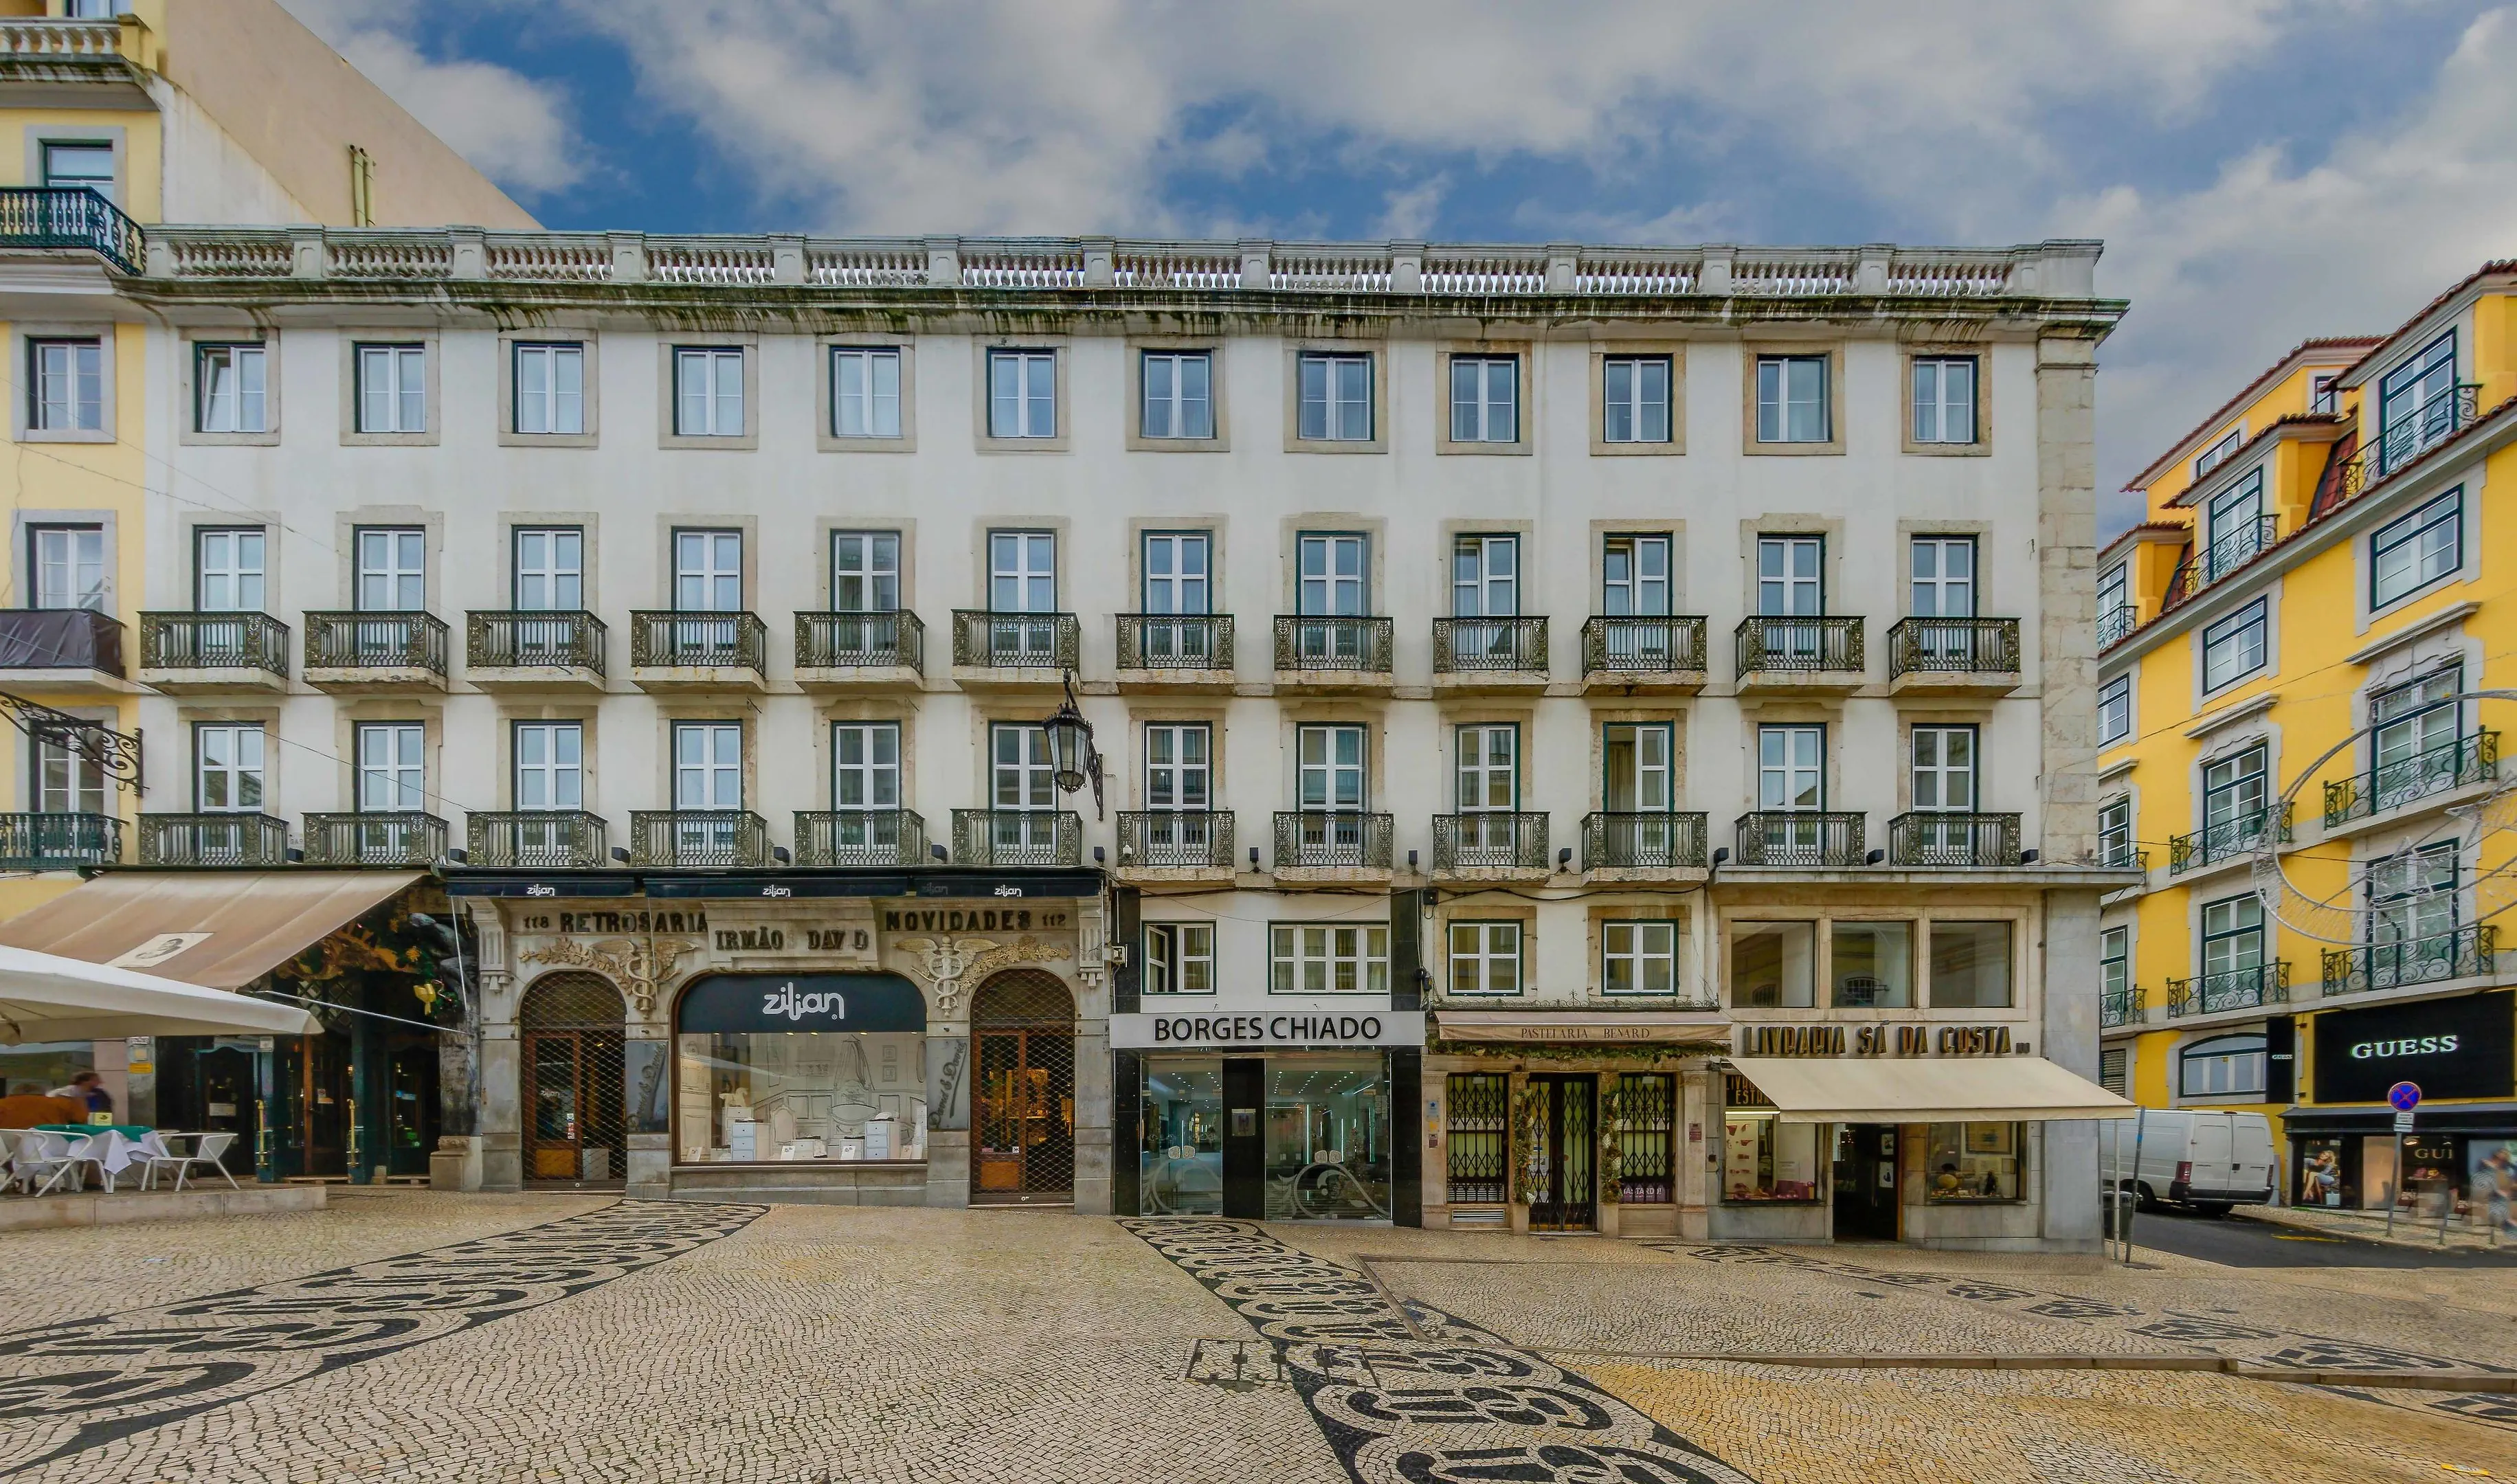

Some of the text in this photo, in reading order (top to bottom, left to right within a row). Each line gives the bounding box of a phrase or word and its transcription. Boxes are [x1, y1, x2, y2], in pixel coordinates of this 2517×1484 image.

[526, 884, 555, 896] zilian
[762, 884, 791, 897] zilian
[994, 884, 1022, 897] zilian
[522, 912, 708, 933] 118 RETROSARIA
[886, 910, 1066, 932] NOVIDADES 112
[762, 982, 844, 1021] zilian
[1154, 1016, 1382, 1042] BORGES CHIADO
[1521, 1028, 1650, 1039] PASTELARIA BENARD
[1743, 1026, 1846, 1055] LIVRARIA
[1857, 1020, 1890, 1055] SÁ
[1898, 1026, 1928, 1054] DA
[1938, 1026, 2012, 1054] COSTA
[2351, 1035, 2459, 1059] GUESS
